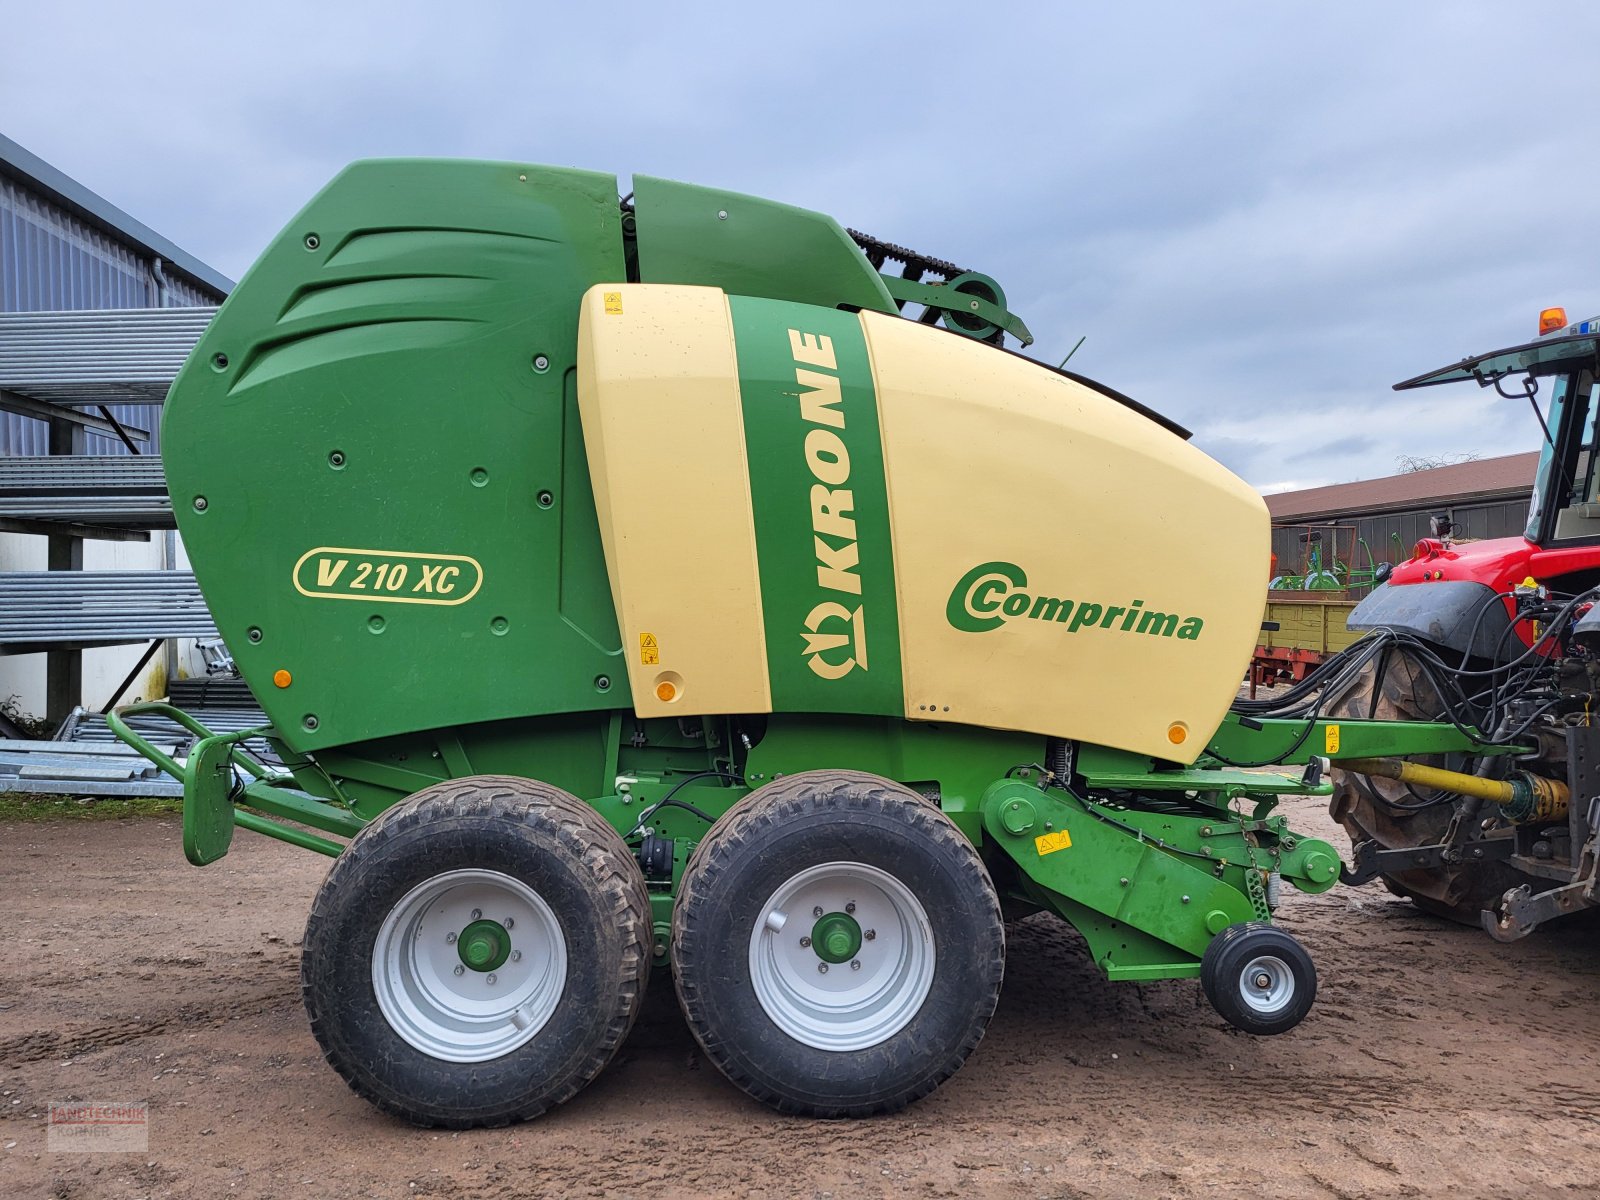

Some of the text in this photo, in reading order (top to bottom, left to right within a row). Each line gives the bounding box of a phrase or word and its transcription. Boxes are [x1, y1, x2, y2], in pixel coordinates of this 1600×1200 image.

[788, 328, 862, 595] KRONE
[317, 558, 461, 594] V 210 XC
